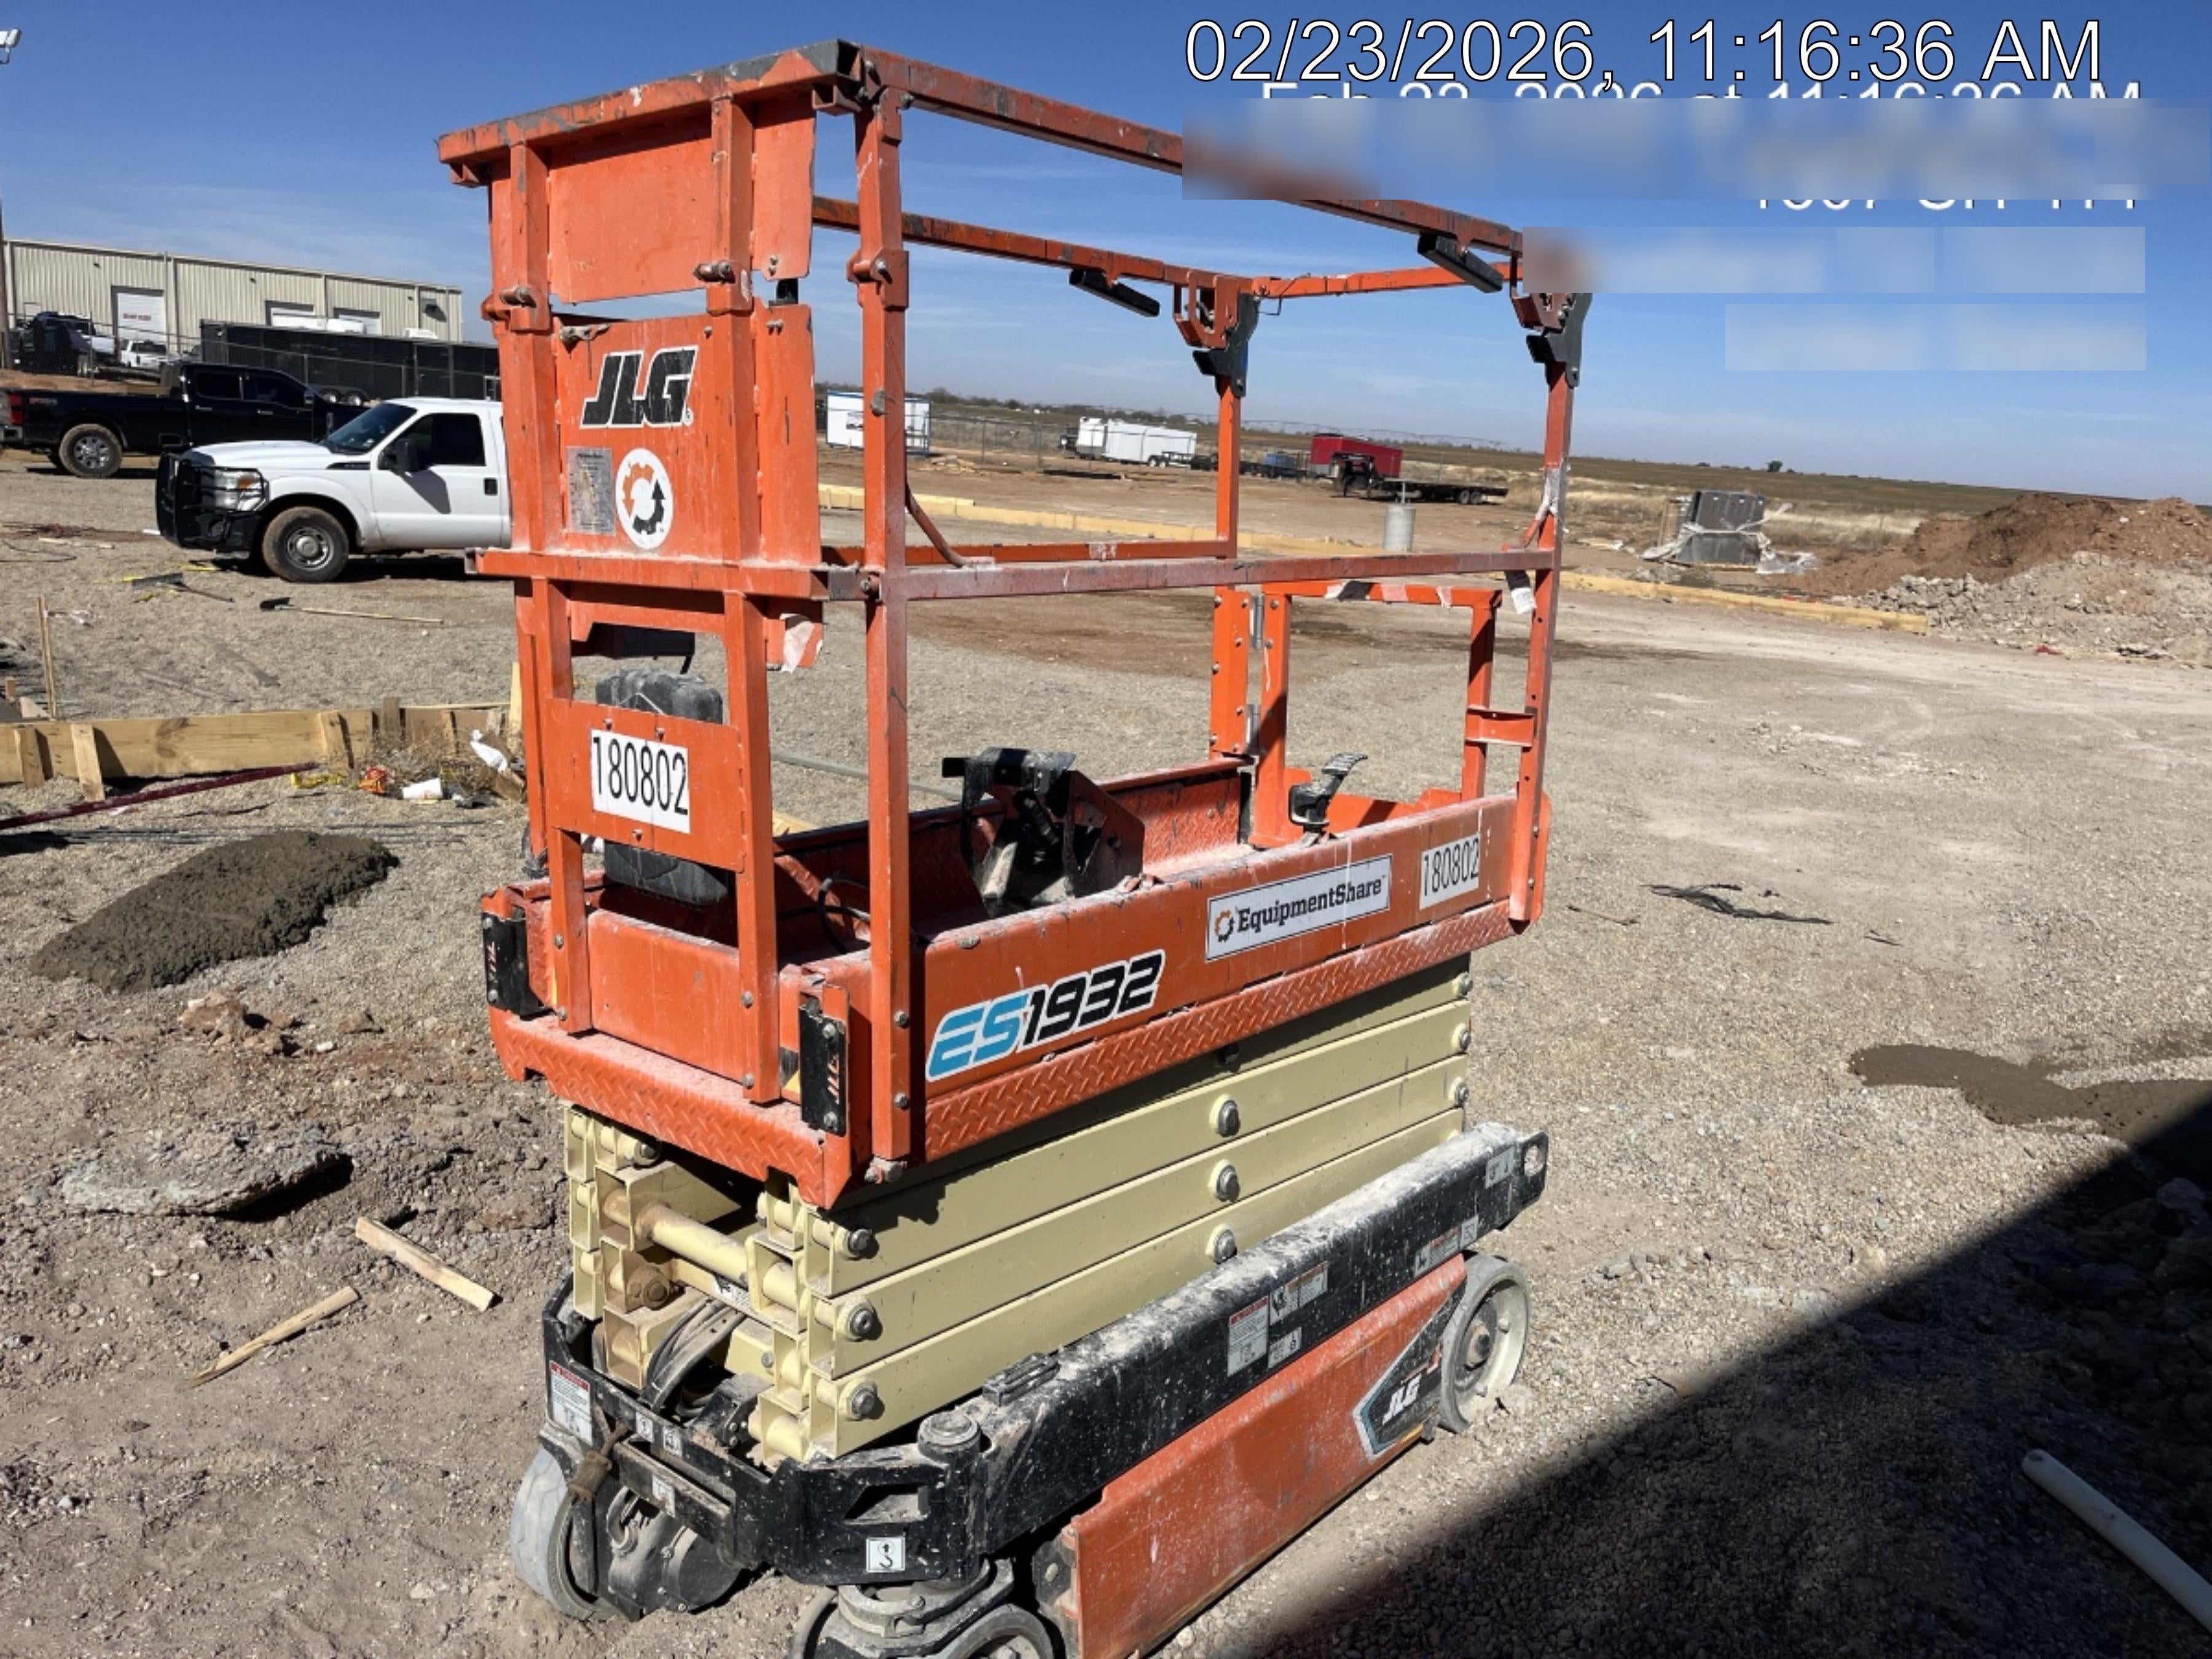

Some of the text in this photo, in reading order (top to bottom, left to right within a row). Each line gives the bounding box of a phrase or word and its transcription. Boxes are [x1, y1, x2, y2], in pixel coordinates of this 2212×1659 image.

[580, 345, 699, 429] JLG
[592, 736, 689, 815] 180802
[1423, 839, 1480, 897] 180802
[1236, 877, 1382, 934] EquipmentShare
[927, 951, 1164, 1080] ES1932
[1382, 1373, 1422, 1426] JLG
